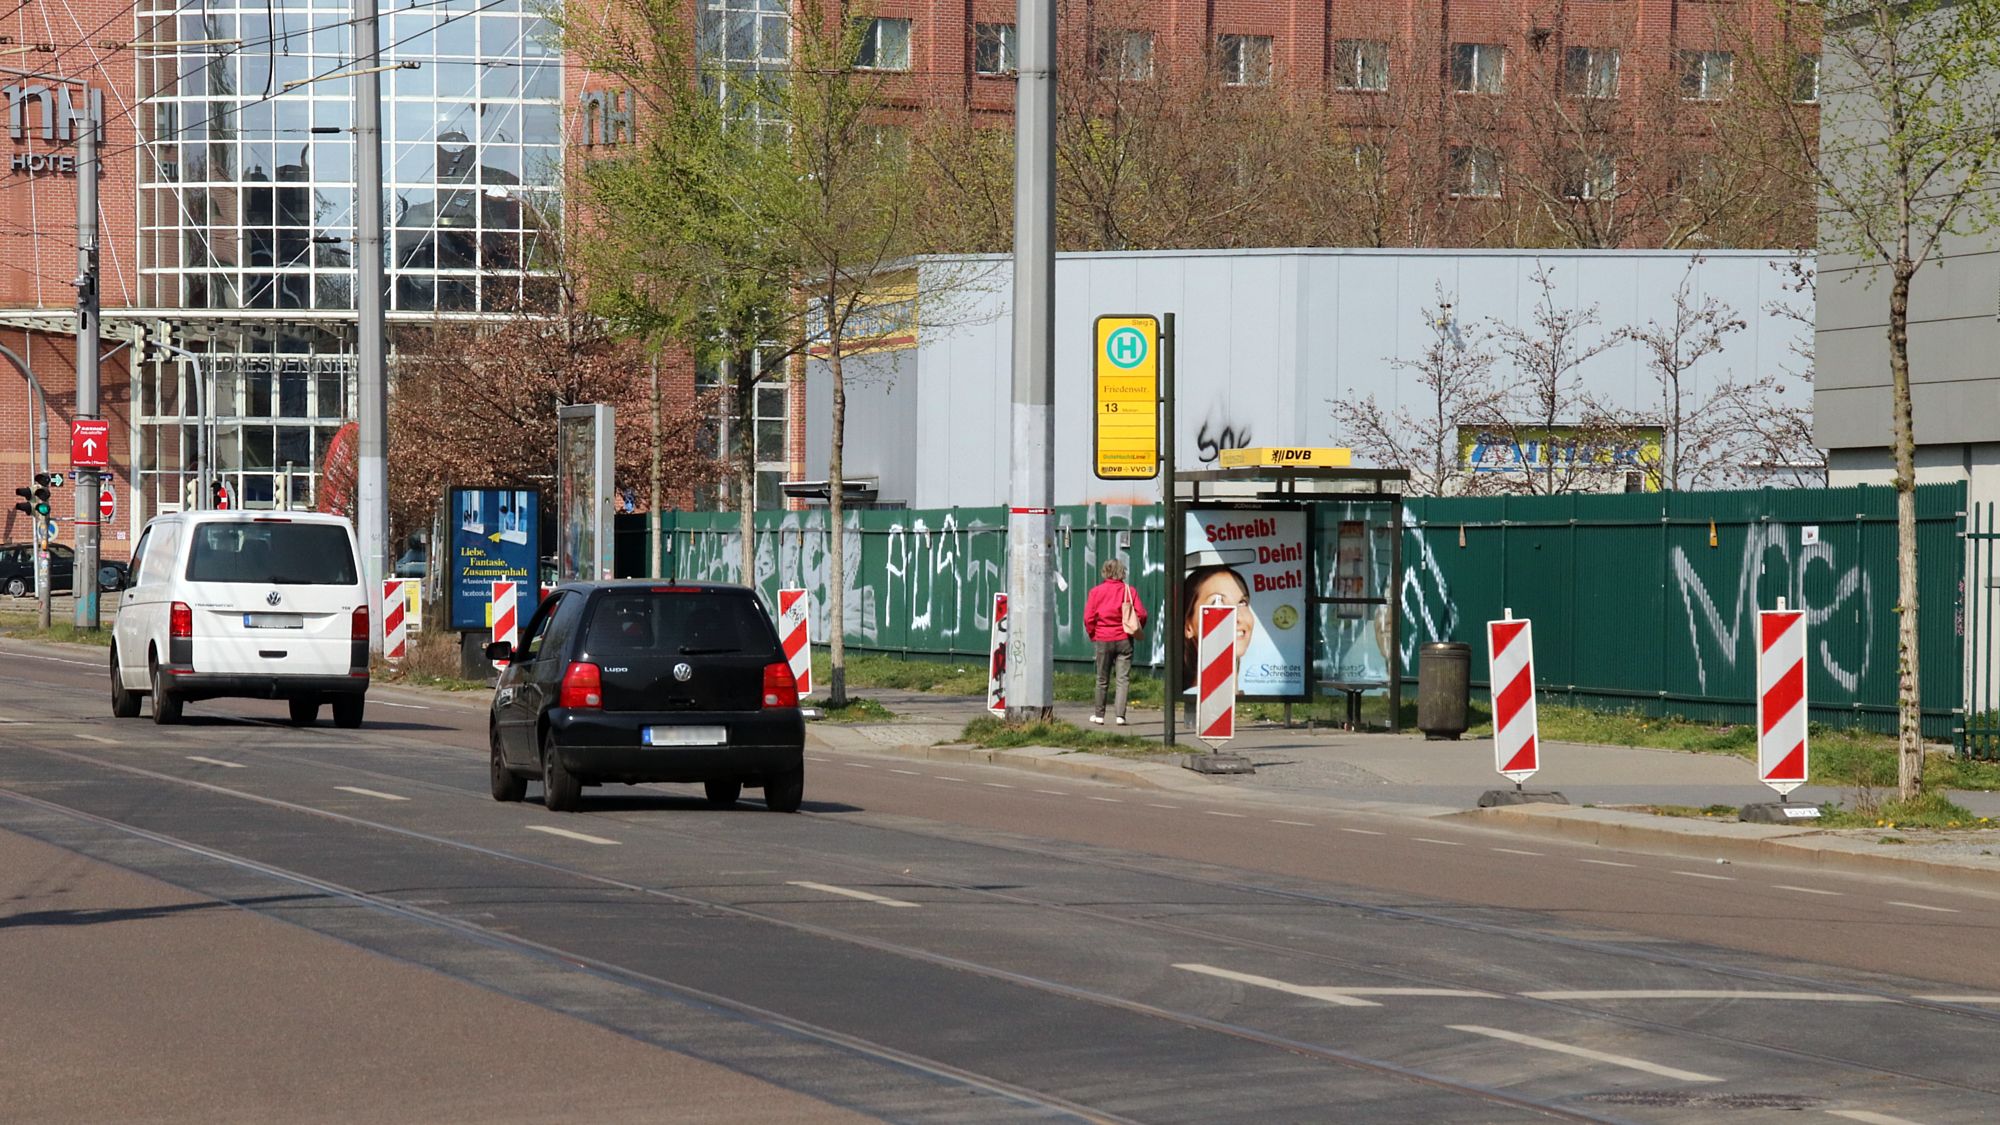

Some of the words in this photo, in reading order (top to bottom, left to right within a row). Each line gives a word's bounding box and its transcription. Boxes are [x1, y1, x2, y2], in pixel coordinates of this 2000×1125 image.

[1117, 336, 1137, 359] H
[1103, 385, 1150, 394] Friedensstr.
[1105, 403, 1118, 412] 13
[1285, 450, 1311, 460] DVB
[1205, 517, 1276, 543] Schreib!
[461, 547, 486, 557] Liebe,
[1258, 541, 1303, 564] Dein!
[470, 558, 507, 567] Fantasie,
[463, 567, 527, 576] Zusammenhalt
[1253, 569, 1302, 593] Buch!
